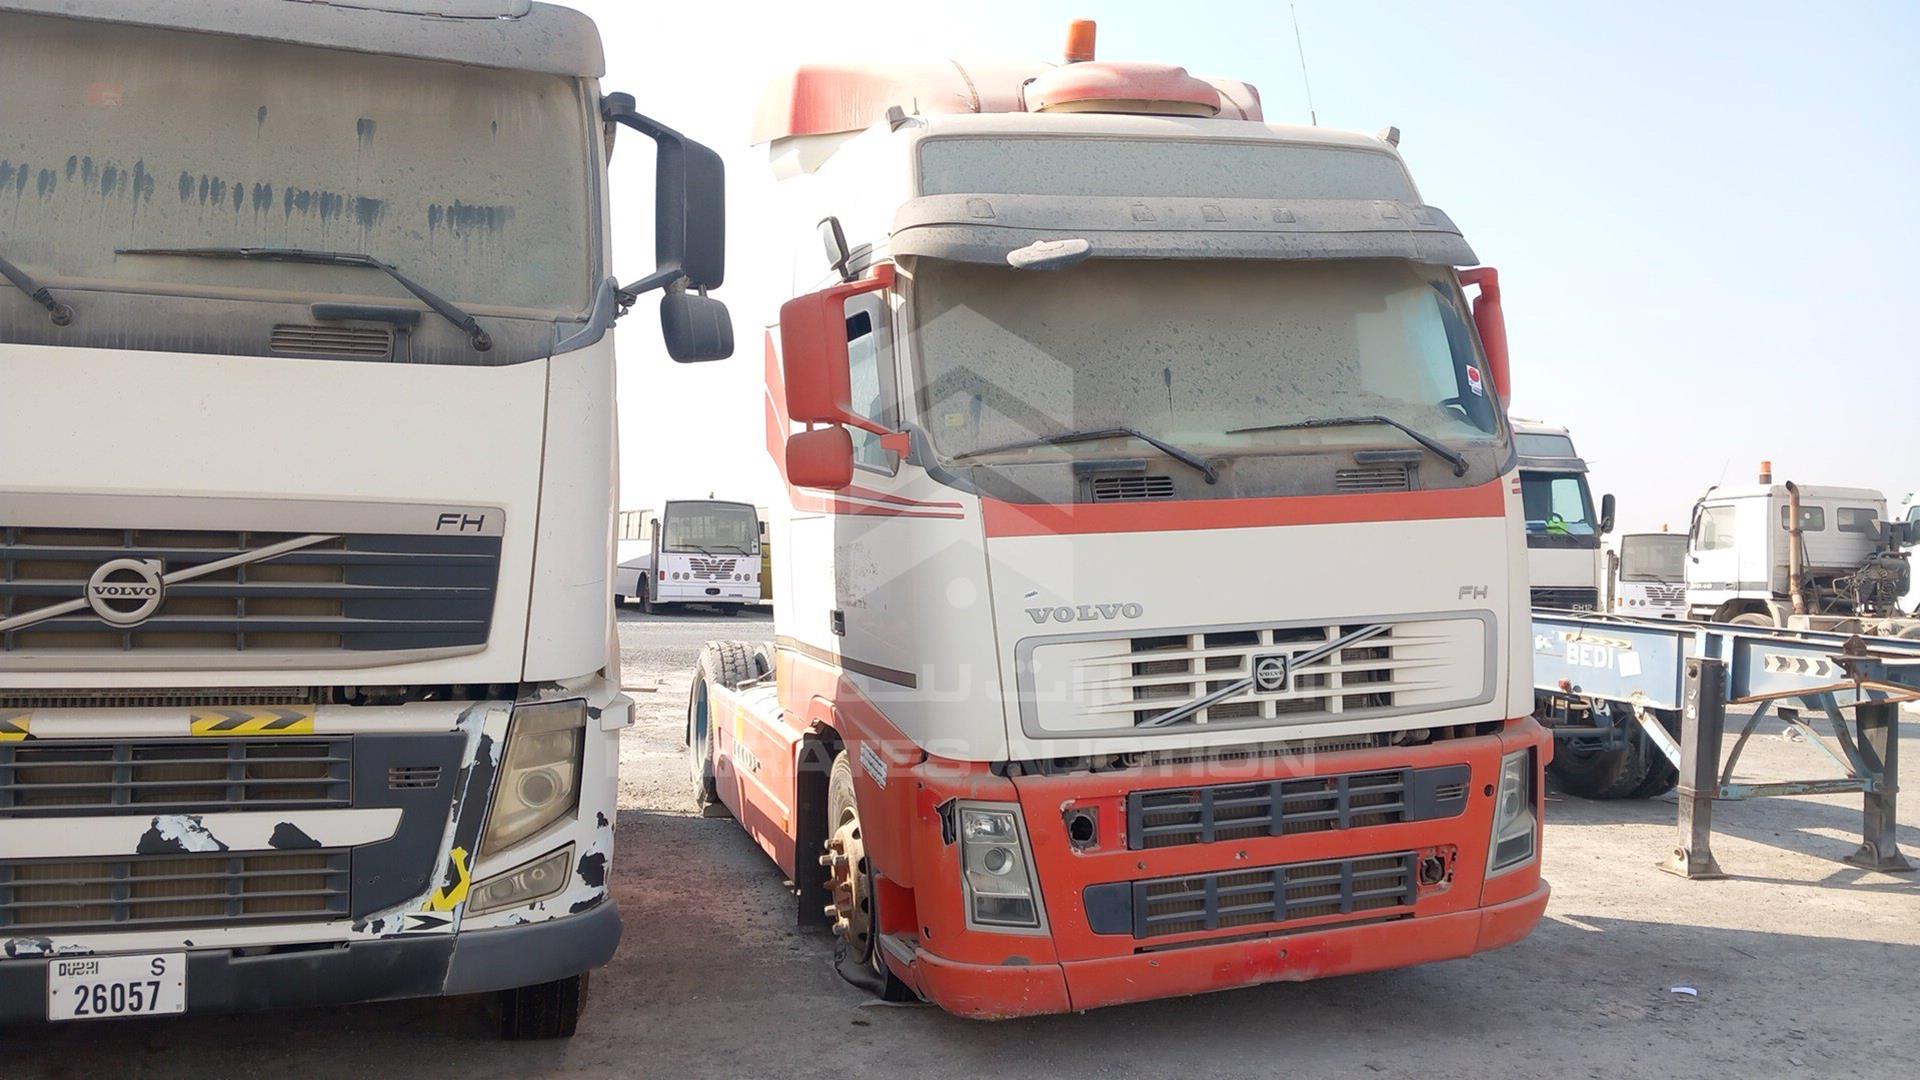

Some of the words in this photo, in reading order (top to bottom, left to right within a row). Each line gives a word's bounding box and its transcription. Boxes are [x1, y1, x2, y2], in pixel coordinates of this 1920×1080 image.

[436, 513, 485, 532] FH
[92, 586, 157, 596] VOLVO
[1458, 585, 1488, 600] FH
[1025, 602, 1144, 625] VOLVO
[1258, 670, 1284, 678] VOLVO
[150, 957, 166, 976] S
[74, 980, 160, 1016] 26057
